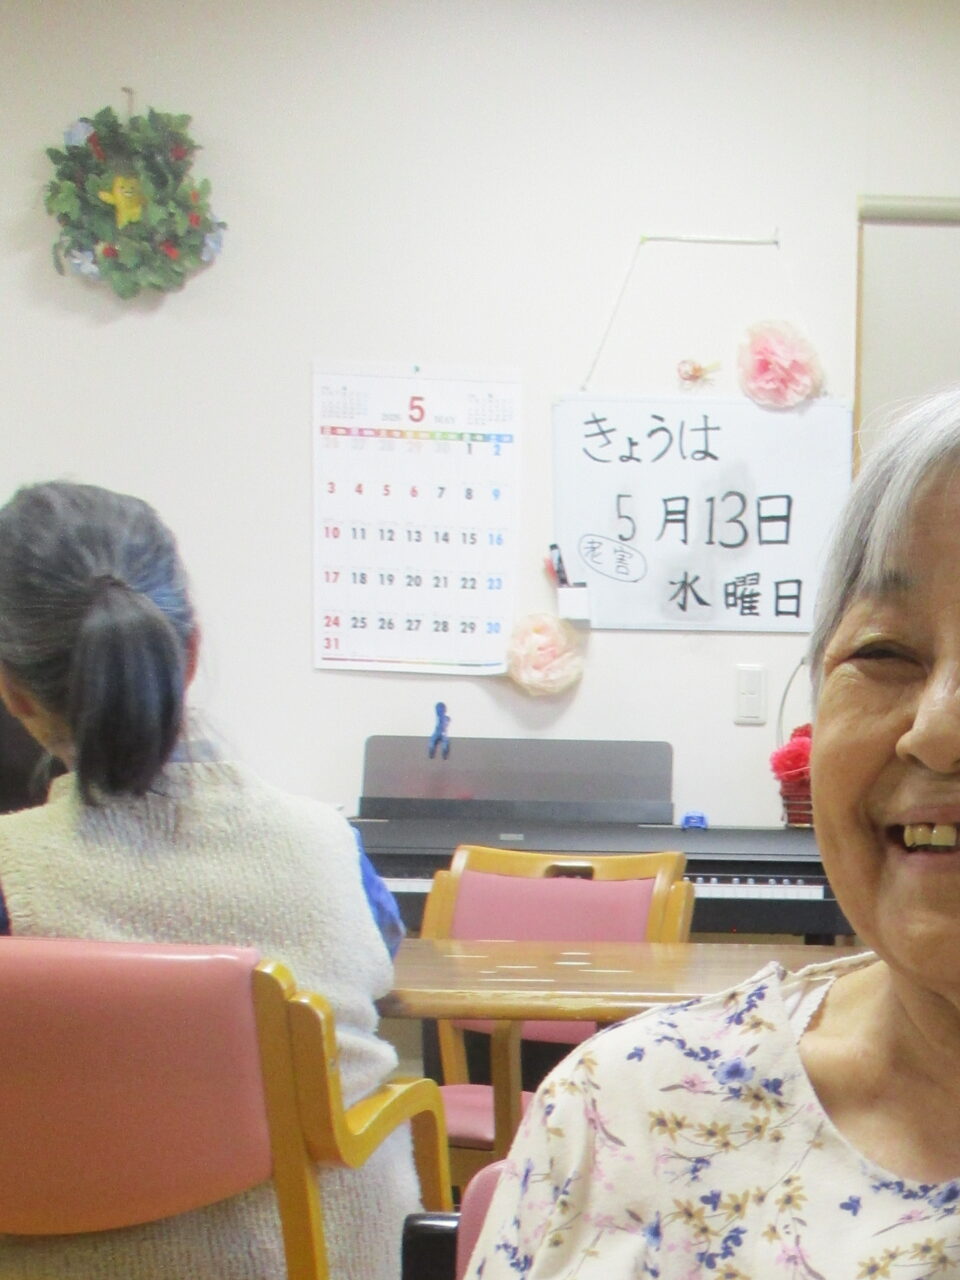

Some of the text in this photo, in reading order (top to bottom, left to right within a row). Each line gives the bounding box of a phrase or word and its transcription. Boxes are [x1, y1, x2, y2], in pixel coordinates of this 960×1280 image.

[409, 396, 425, 422] 5
[583, 413, 720, 463] きょうは
[327, 481, 501, 501] 3 4 5 6 7 8 9
[616, 491, 793, 549] 5月13日
[324, 526, 503, 546] 10 11 12 13 14 15 16
[324, 570, 503, 591] 17 18 19 20 21 22 23
[669, 571, 803, 618] 水曜日
[324, 615, 501, 634] 24 25 26 27 28 29 30
[324, 637, 339, 650] 31
